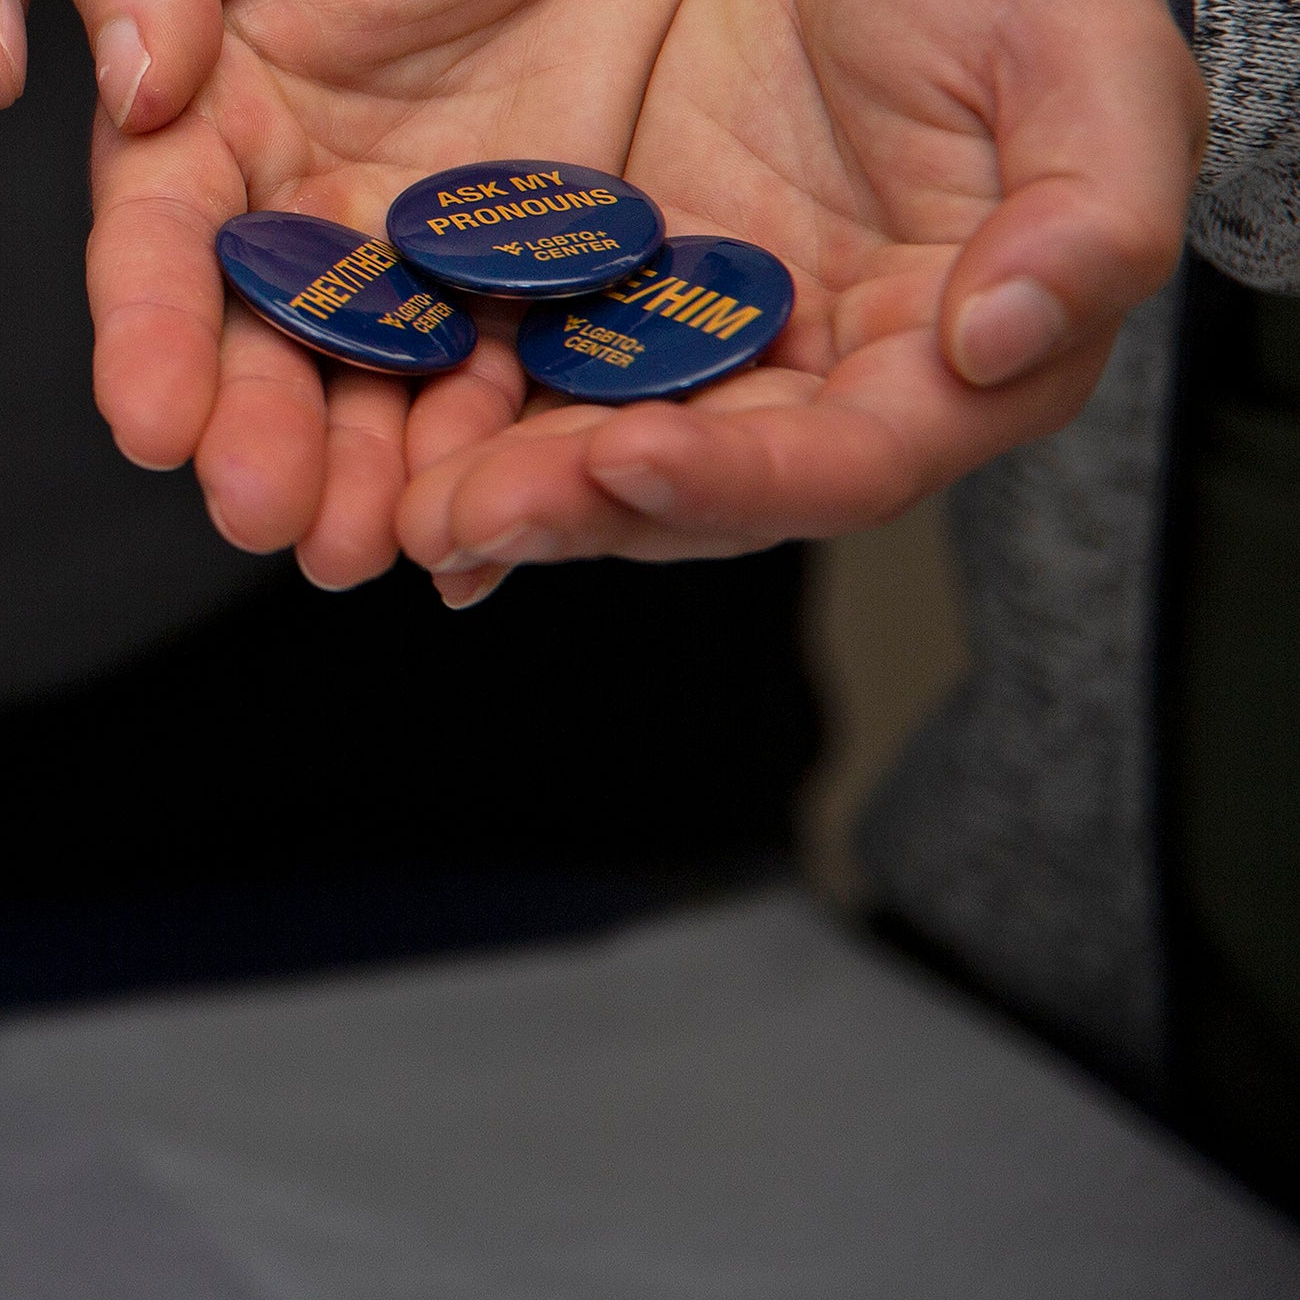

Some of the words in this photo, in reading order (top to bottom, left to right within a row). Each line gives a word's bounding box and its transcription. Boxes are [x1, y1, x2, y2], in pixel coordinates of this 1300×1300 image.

[436, 181, 509, 208] ASK
[509, 170, 564, 192] MY
[426, 188, 619, 236] PRONOUNS
[525, 230, 608, 251] LGBTQ+
[534, 239, 620, 261] CENTER
[394, 292, 435, 323] LGBTQ+
[411, 301, 455, 334] CENTER
[564, 336, 635, 369] CENTER
[578, 324, 645, 354] LGBTQ+
